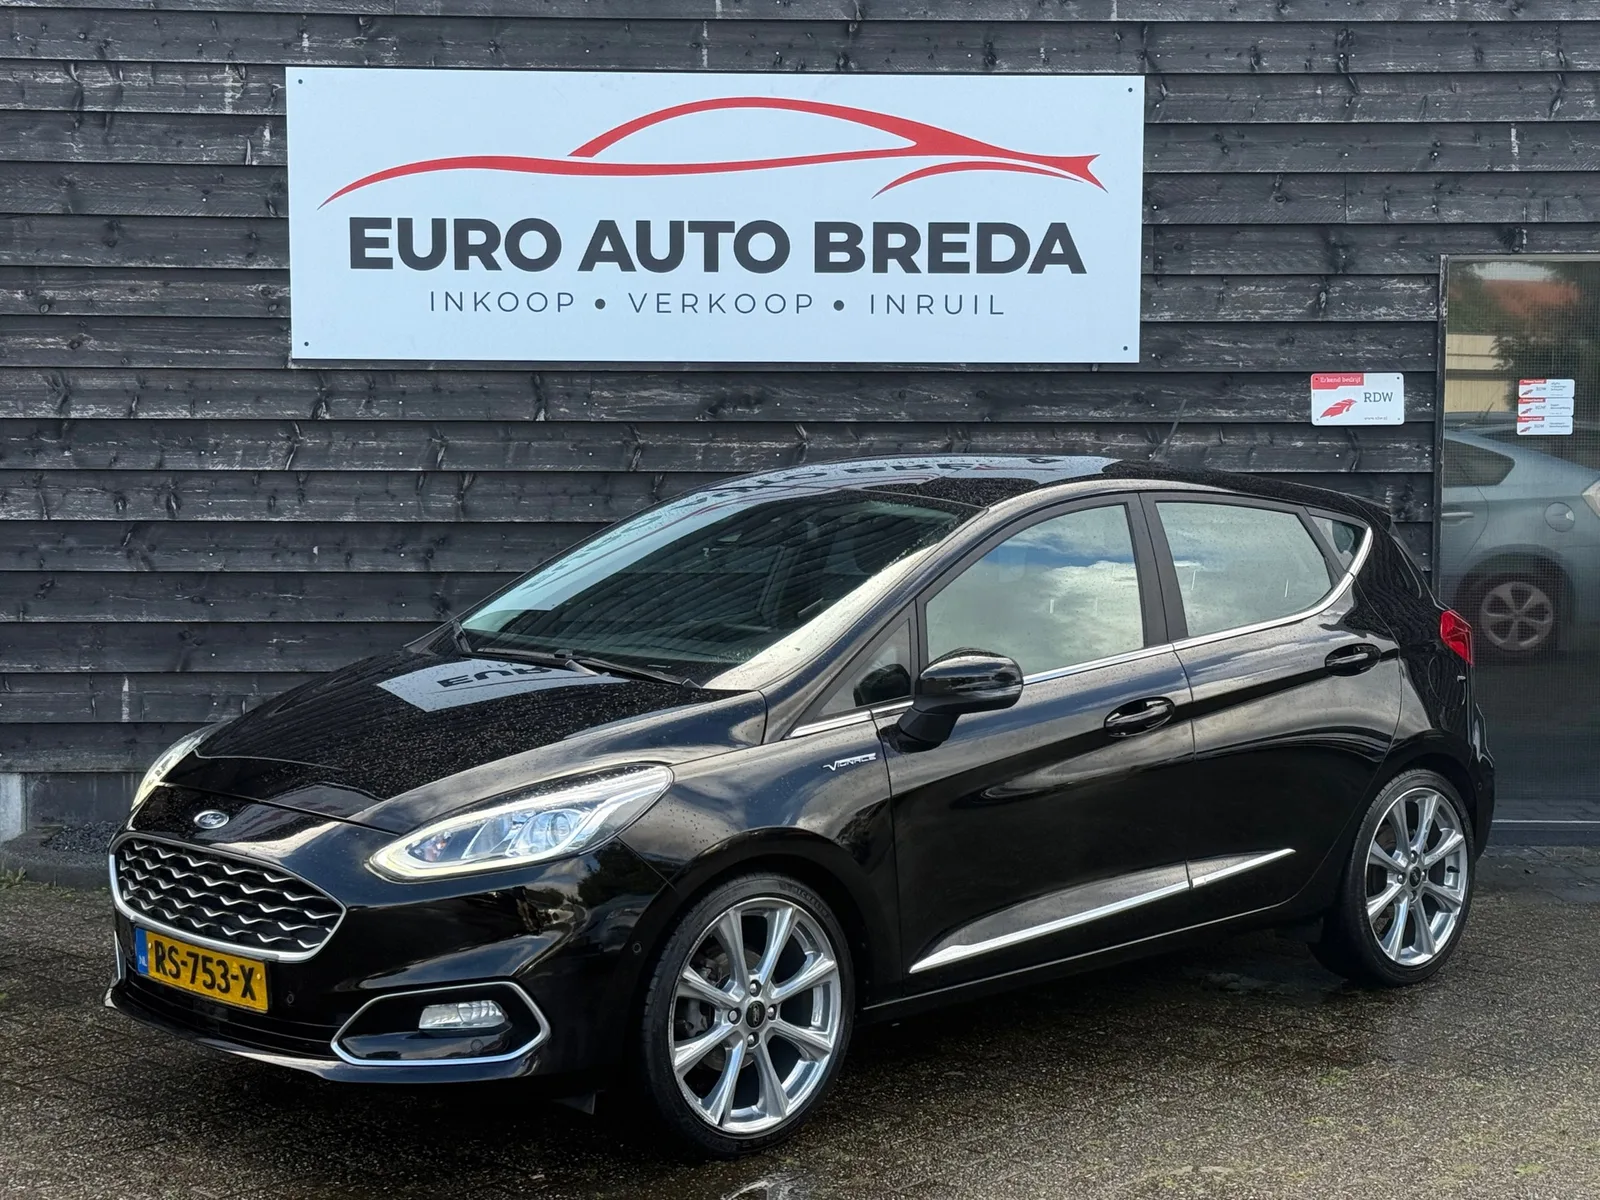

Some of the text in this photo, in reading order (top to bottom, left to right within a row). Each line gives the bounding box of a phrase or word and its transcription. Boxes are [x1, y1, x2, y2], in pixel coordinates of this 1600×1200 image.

[350, 217, 1087, 274] EURO AUTO BREDA
[429, 292, 1006, 315] INKOOP VERKOOP INRUIL
[1363, 391, 1393, 403] RDW
[139, 955, 148, 967] NL
[154, 940, 257, 1001] RS-753-X
